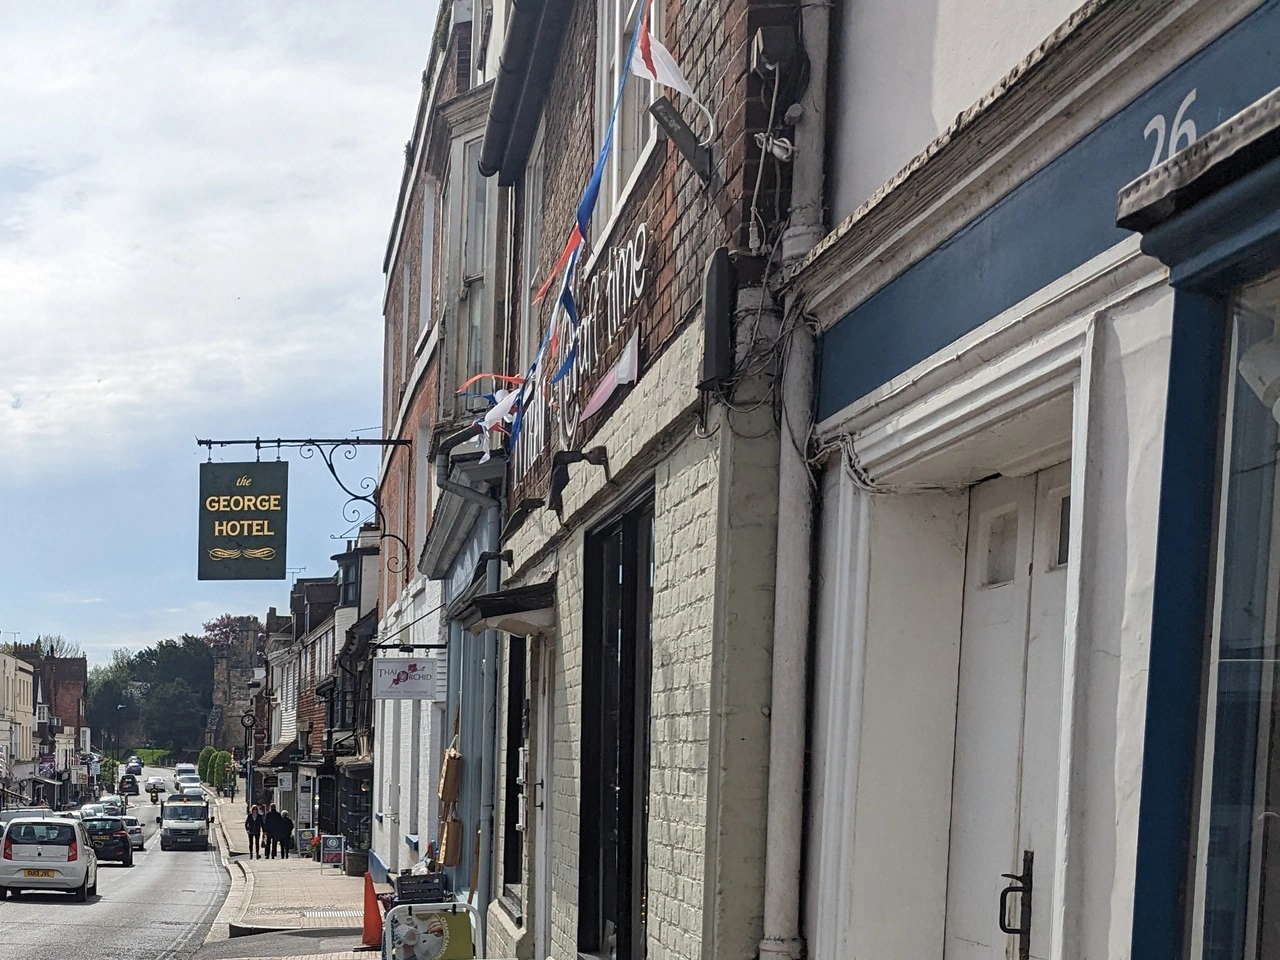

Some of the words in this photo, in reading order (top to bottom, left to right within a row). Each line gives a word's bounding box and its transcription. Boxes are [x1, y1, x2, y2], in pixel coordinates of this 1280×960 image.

[1144, 87, 1197, 171] 26
[606, 222, 648, 346] time
[235, 475, 252, 487] the
[205, 495, 282, 512] GEORGE
[213, 520, 275, 536] HOTEL
[378, 668, 397, 678] THAI
[397, 670, 433, 683] ORCHID
